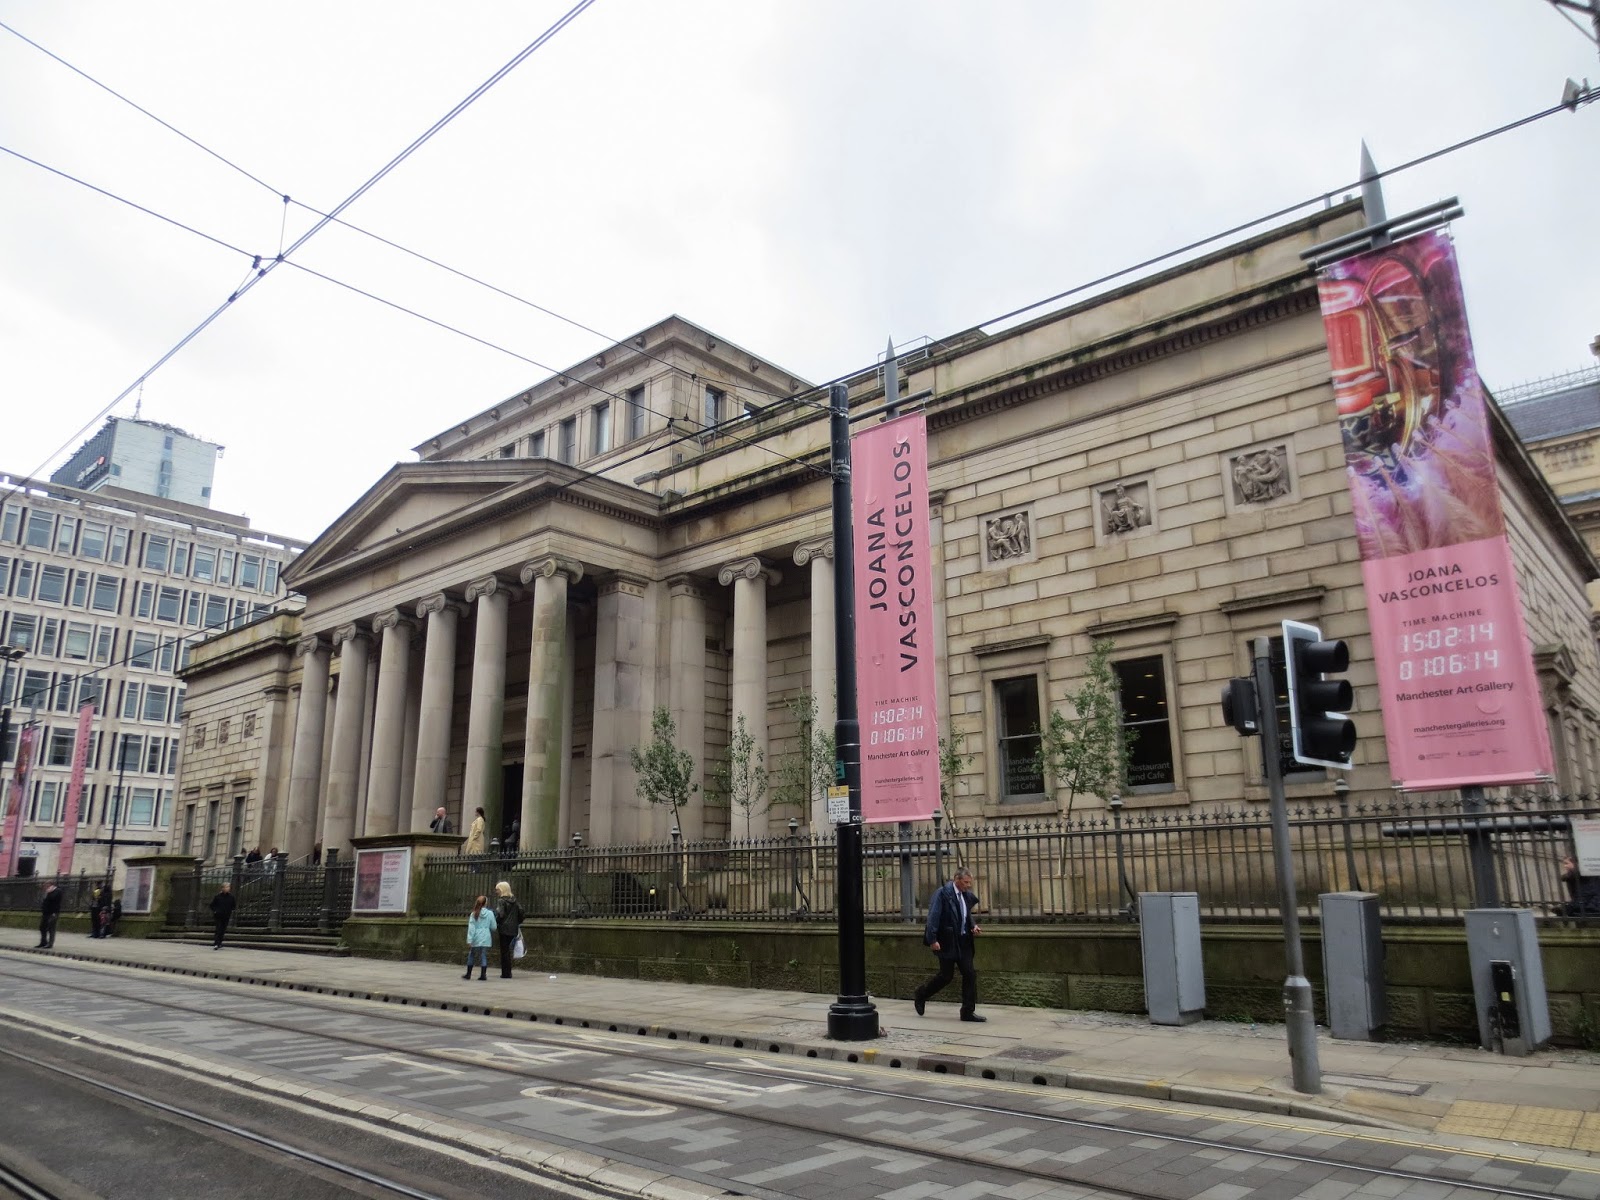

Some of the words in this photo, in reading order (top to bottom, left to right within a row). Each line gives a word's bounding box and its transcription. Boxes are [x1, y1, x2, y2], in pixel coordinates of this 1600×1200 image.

[867, 507, 888, 612] JOANA
[893, 441, 918, 673] VASCONCELOS
[1407, 563, 1462, 583] JOANA
[1378, 574, 1499, 604] VASCONCELOS
[1402, 617, 1427, 627] TIME
[1431, 608, 1482, 623] MACHINE
[1403, 622, 1493, 653] 15:02:14
[875, 699, 888, 707] TIME
[890, 695, 919, 704] MACHINE
[1396, 688, 1454, 702] Manchester
[1456, 685, 1474, 695] Art
[1475, 681, 1514, 692] Gallery
[1413, 718, 1506, 733] manchestergalleries.org
[867, 751, 899, 761] Manchester
[899, 750, 909, 758] Art
[910, 748, 930, 757] Gallery
[1129, 762, 1171, 772] Restaurant
[1147, 770, 1165, 780] Cafe
[519, 1057, 854, 1117] ONLY
